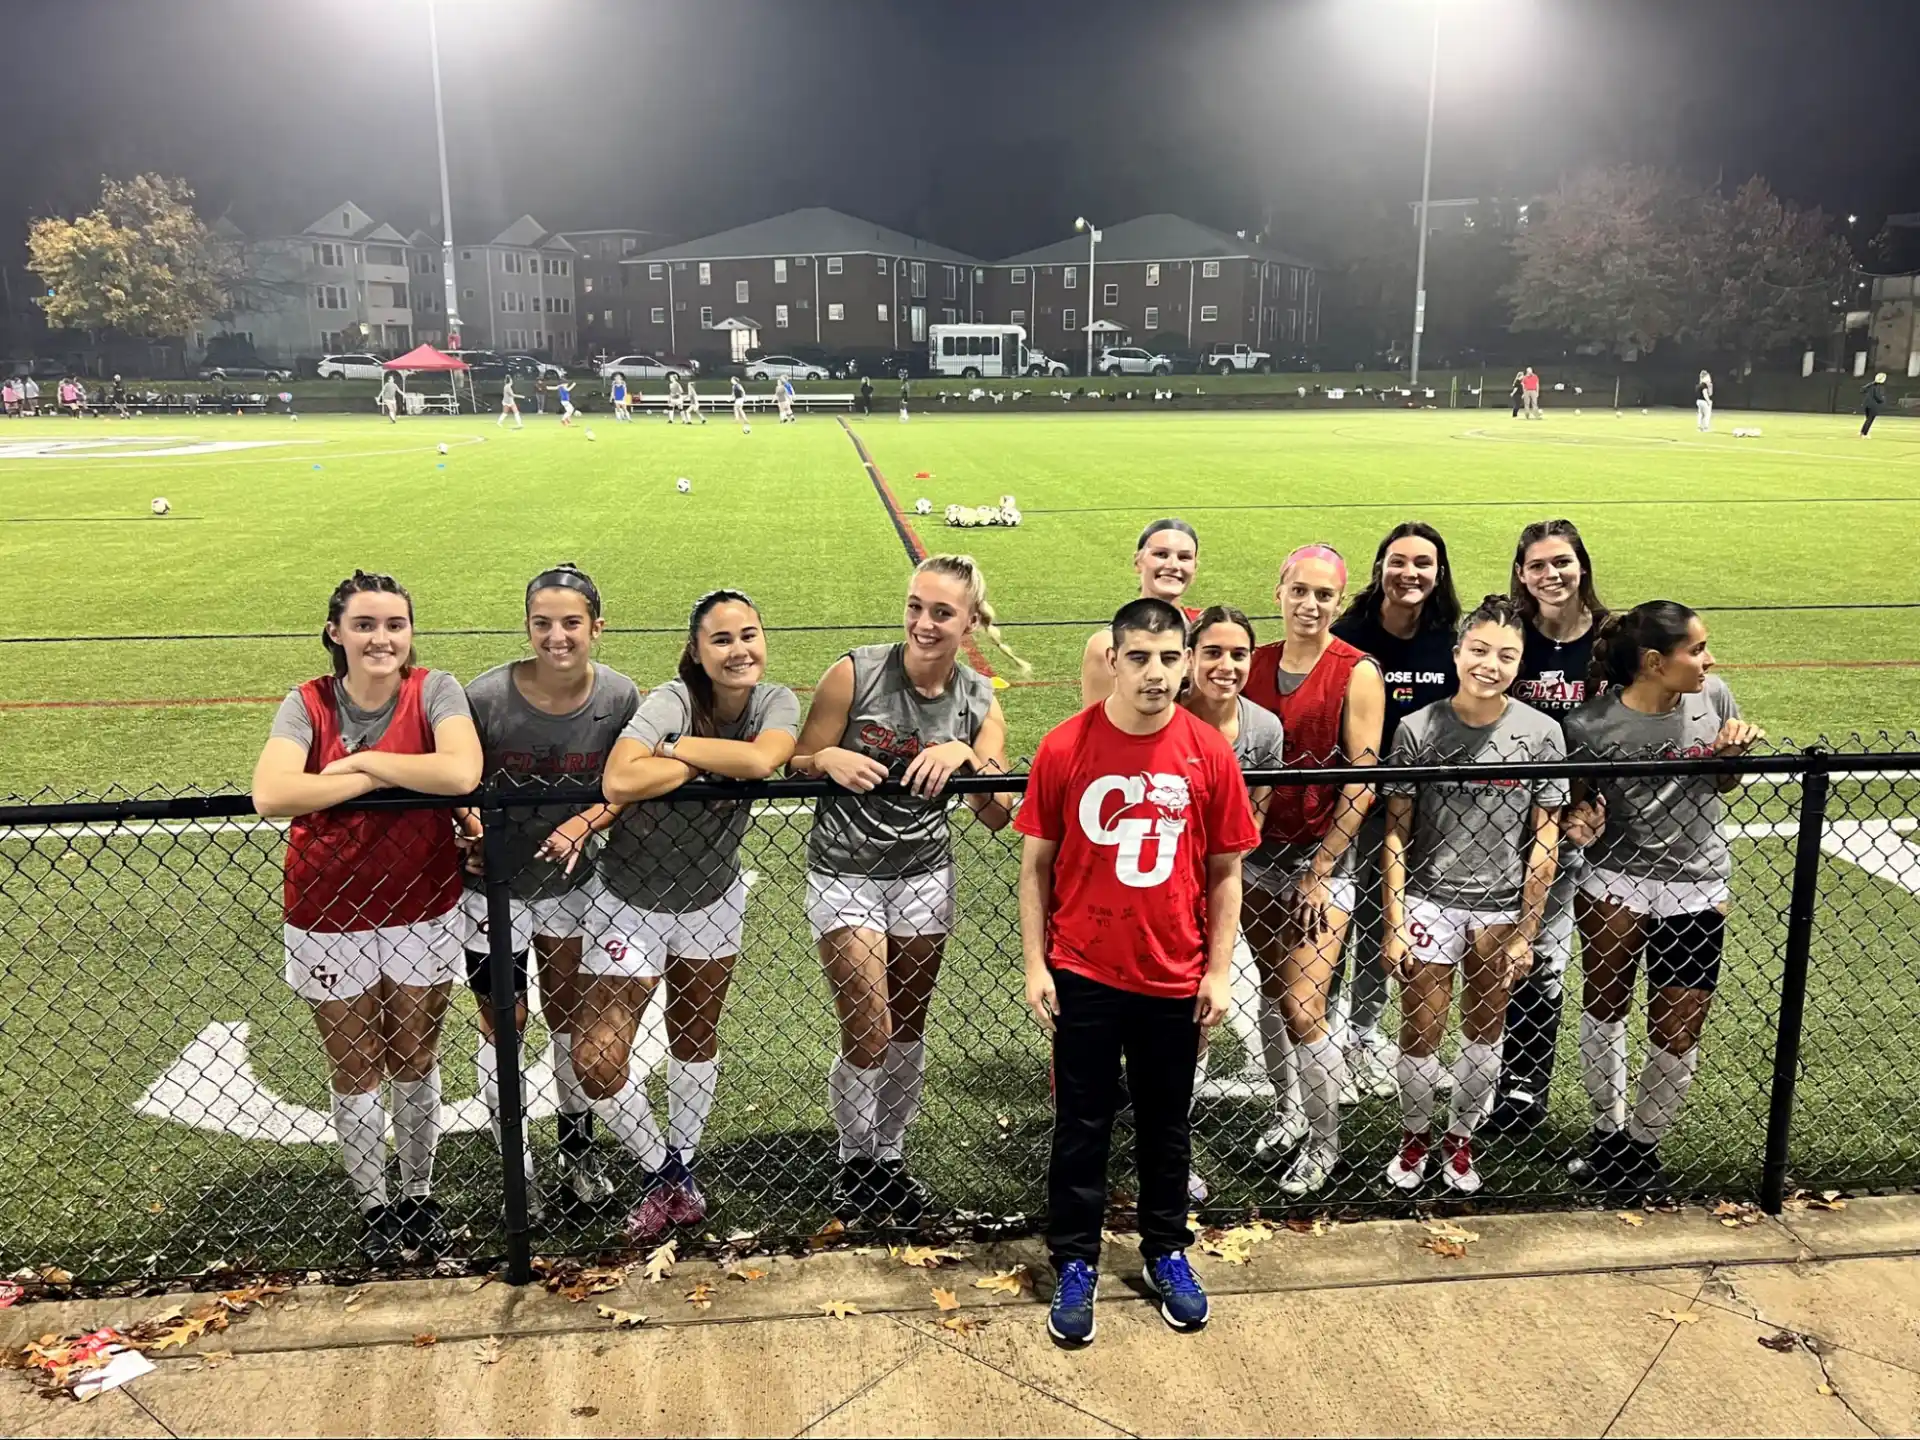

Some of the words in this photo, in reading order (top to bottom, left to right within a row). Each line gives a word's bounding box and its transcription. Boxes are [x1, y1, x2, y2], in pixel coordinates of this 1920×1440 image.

[1384, 671, 1413, 684] OSE
[1415, 671, 1445, 685] LOVE
[1078, 774, 1188, 888] CU
